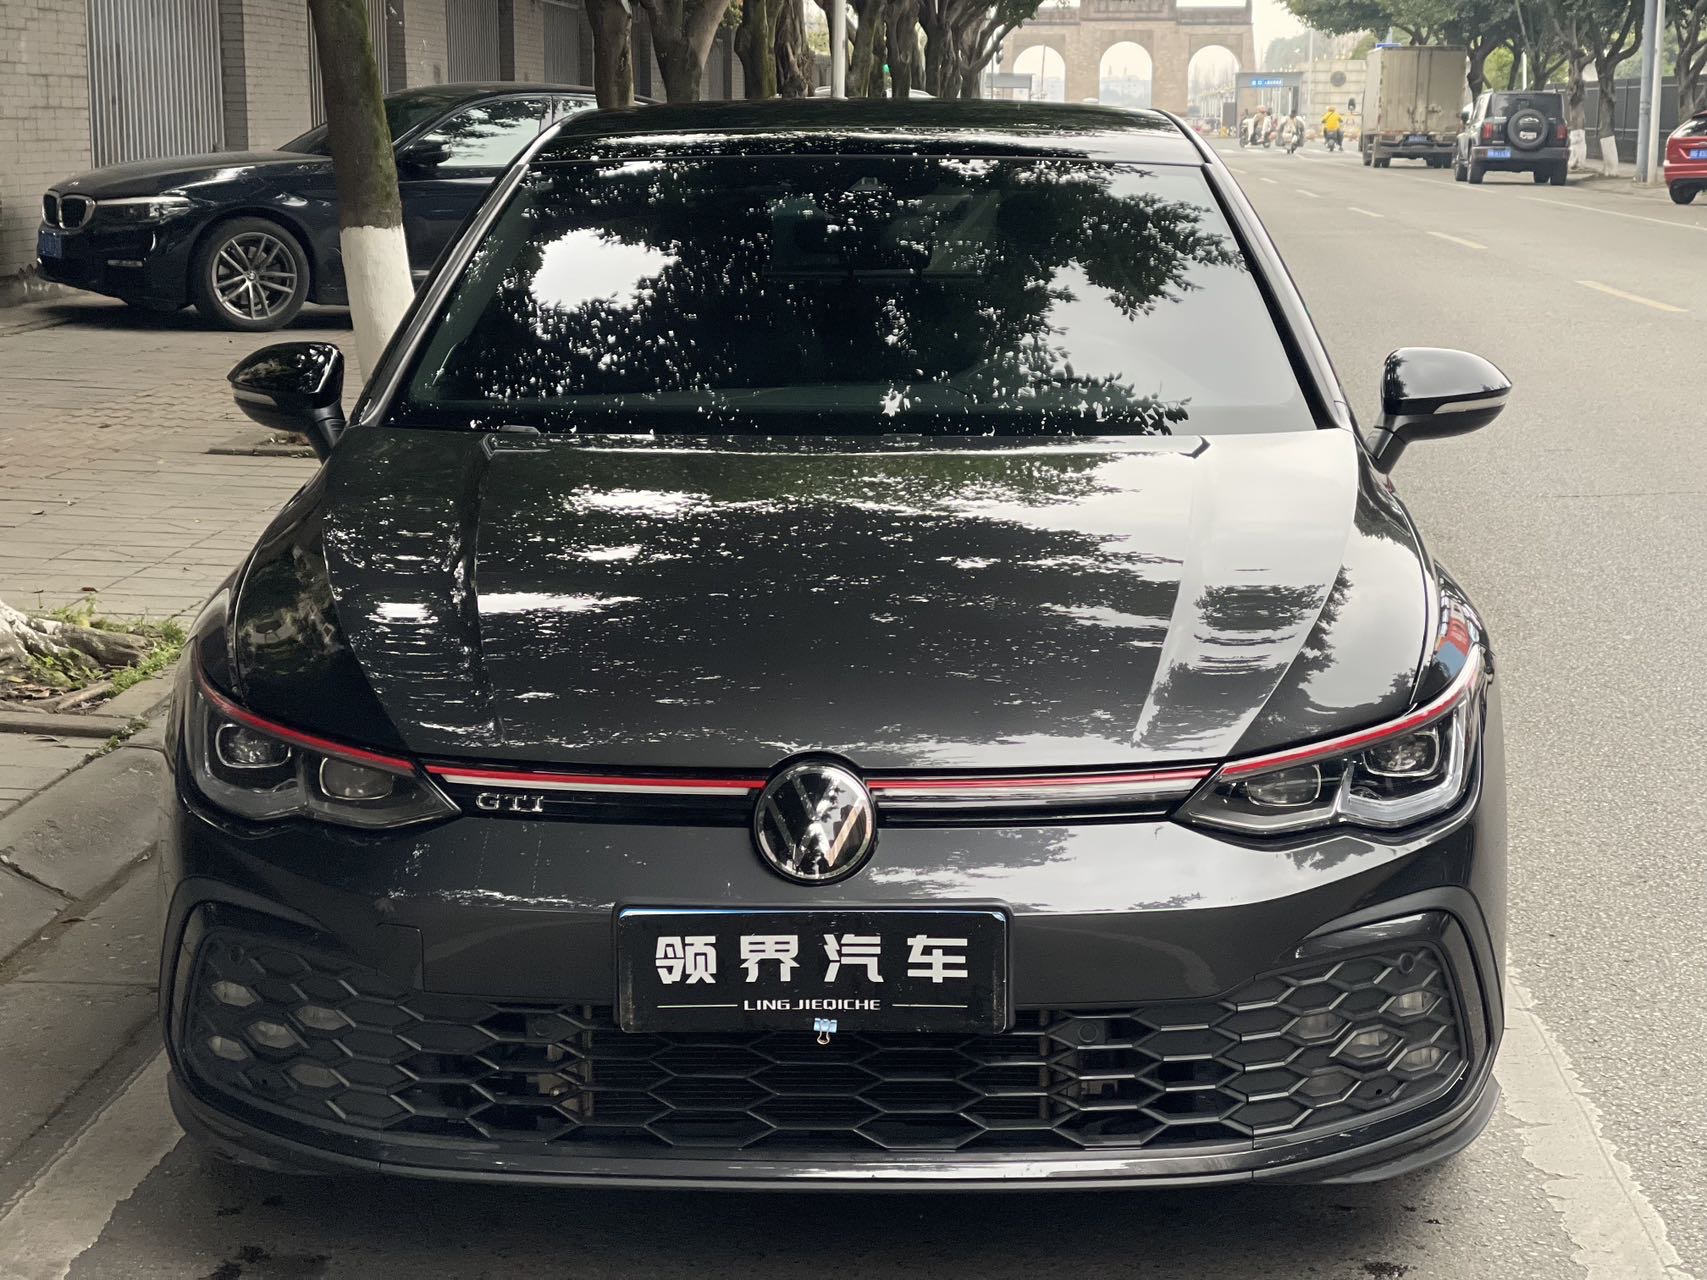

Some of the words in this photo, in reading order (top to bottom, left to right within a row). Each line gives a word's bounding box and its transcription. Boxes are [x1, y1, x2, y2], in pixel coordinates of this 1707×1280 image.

[475, 792, 544, 812] GTI
[655, 934, 969, 984] 领界汽车
